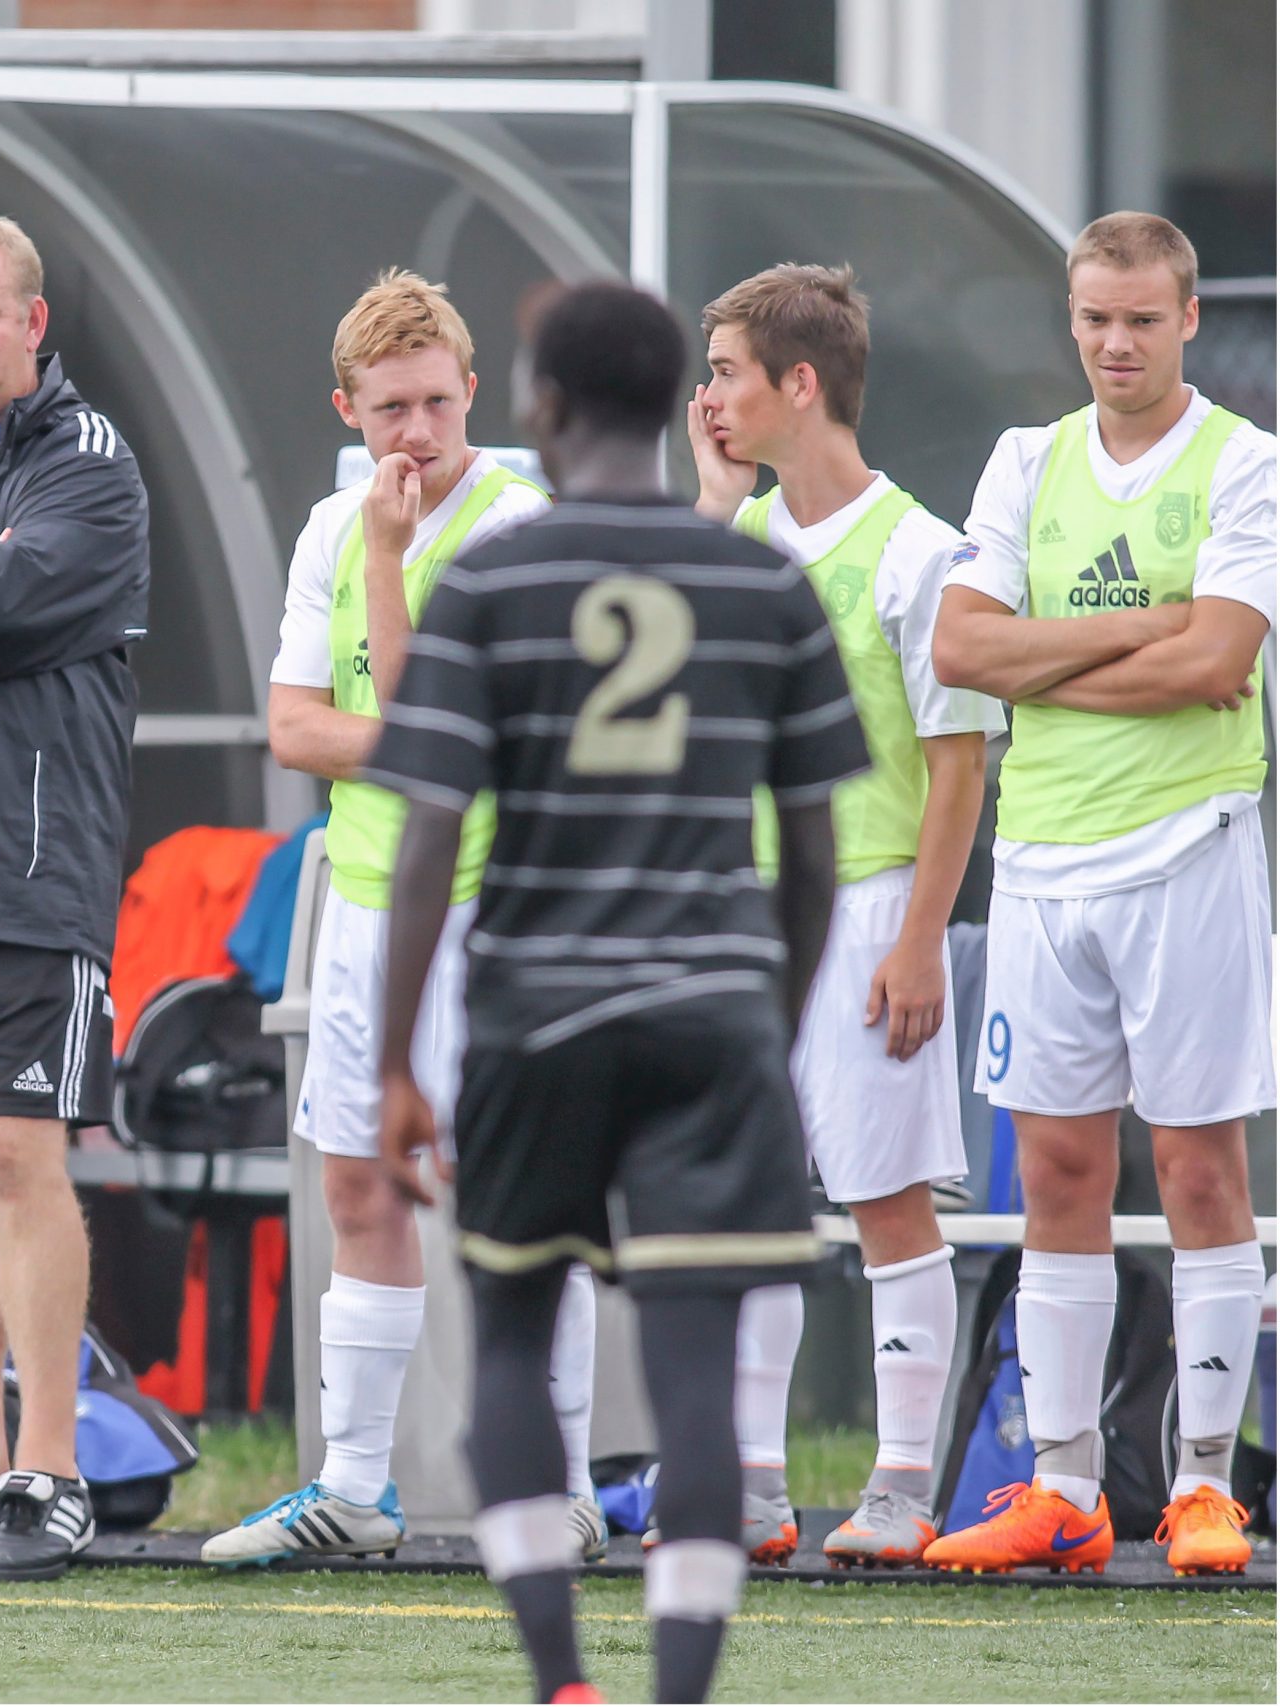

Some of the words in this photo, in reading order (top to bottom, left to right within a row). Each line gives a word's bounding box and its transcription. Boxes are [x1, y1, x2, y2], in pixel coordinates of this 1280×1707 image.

[1069, 579, 1151, 609] adidas
[565, 573, 697, 776] 2
[987, 1009, 1012, 1083] 9
[12, 1079, 54, 1093] adidas
